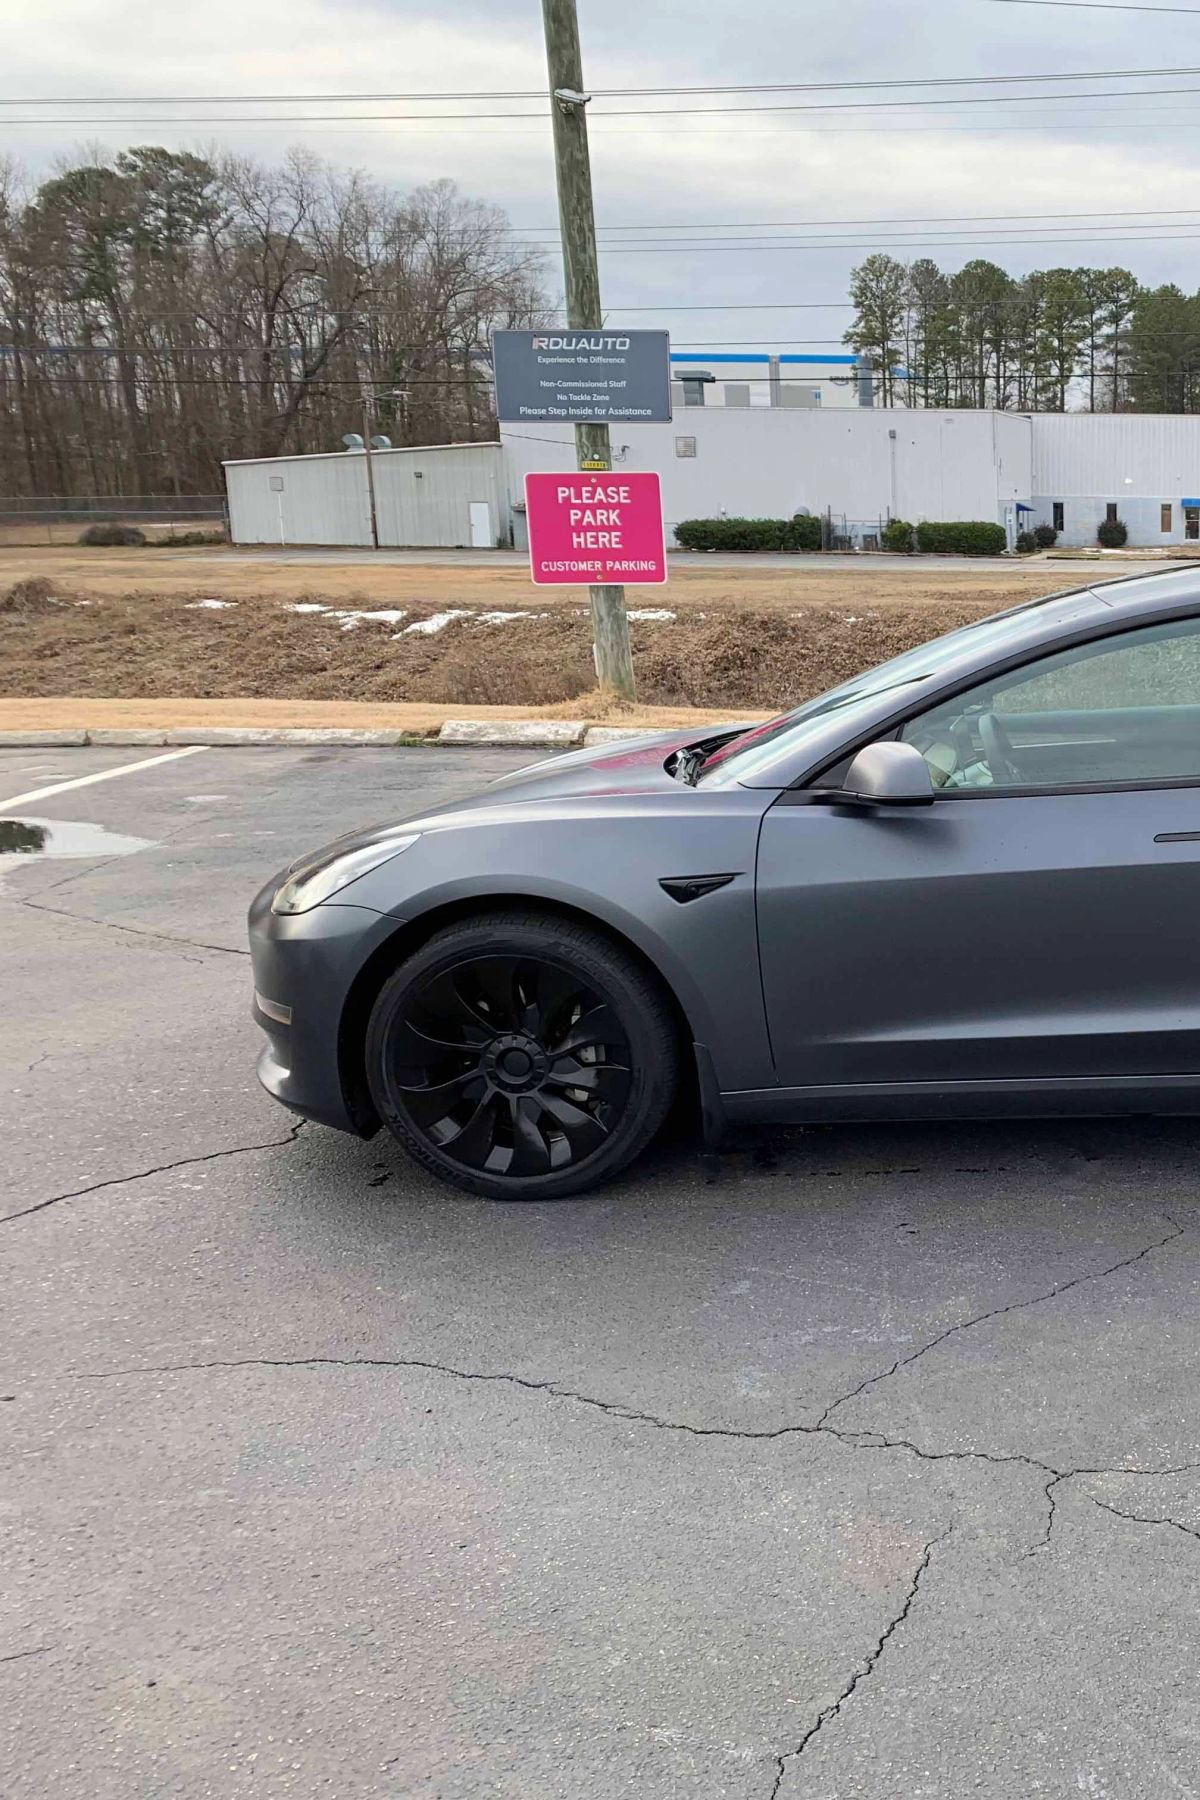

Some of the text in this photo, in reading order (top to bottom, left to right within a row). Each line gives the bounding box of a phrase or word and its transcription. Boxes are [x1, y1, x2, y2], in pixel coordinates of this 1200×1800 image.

[537, 356, 626, 364] Experience the Difference
[540, 380, 627, 388] Non-Commissioned Staff
[557, 393, 567, 401] No
[592, 393, 610, 401] Zone
[520, 406, 652, 417] Please Step Inside for Assistance
[557, 486, 632, 504] PLEASE
[569, 509, 622, 527] PARK
[572, 531, 624, 549] HERE
[541, 560, 657, 572] CUSTOMER PARKING
